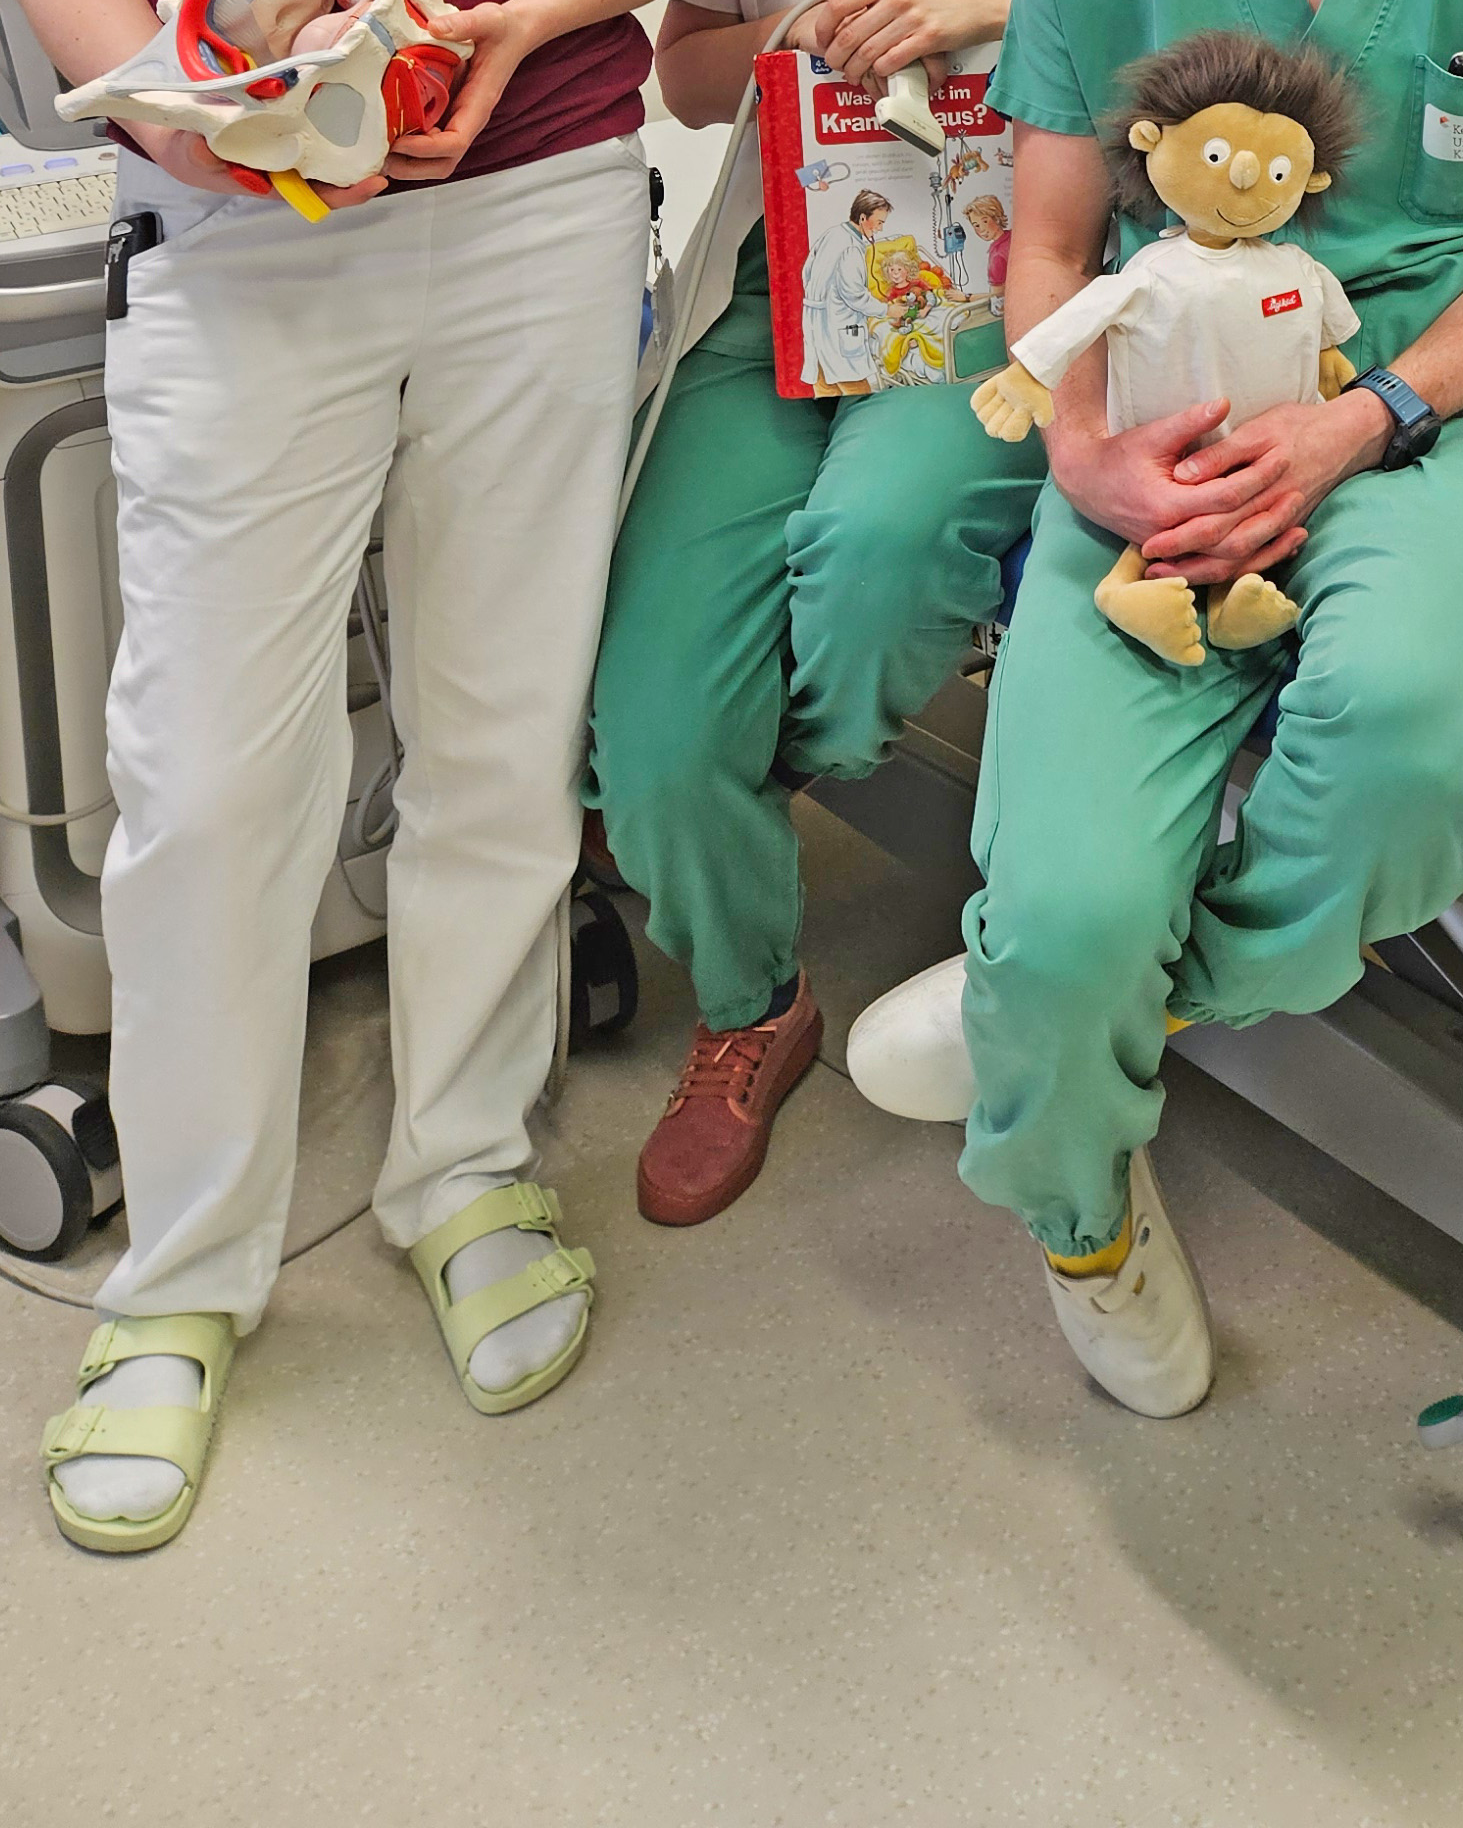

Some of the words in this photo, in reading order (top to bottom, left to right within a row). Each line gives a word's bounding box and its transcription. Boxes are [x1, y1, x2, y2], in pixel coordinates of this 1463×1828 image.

[836, 91, 873, 106] Was
[949, 86, 971, 100] im
[822, 103, 988, 133] Kranaus?
